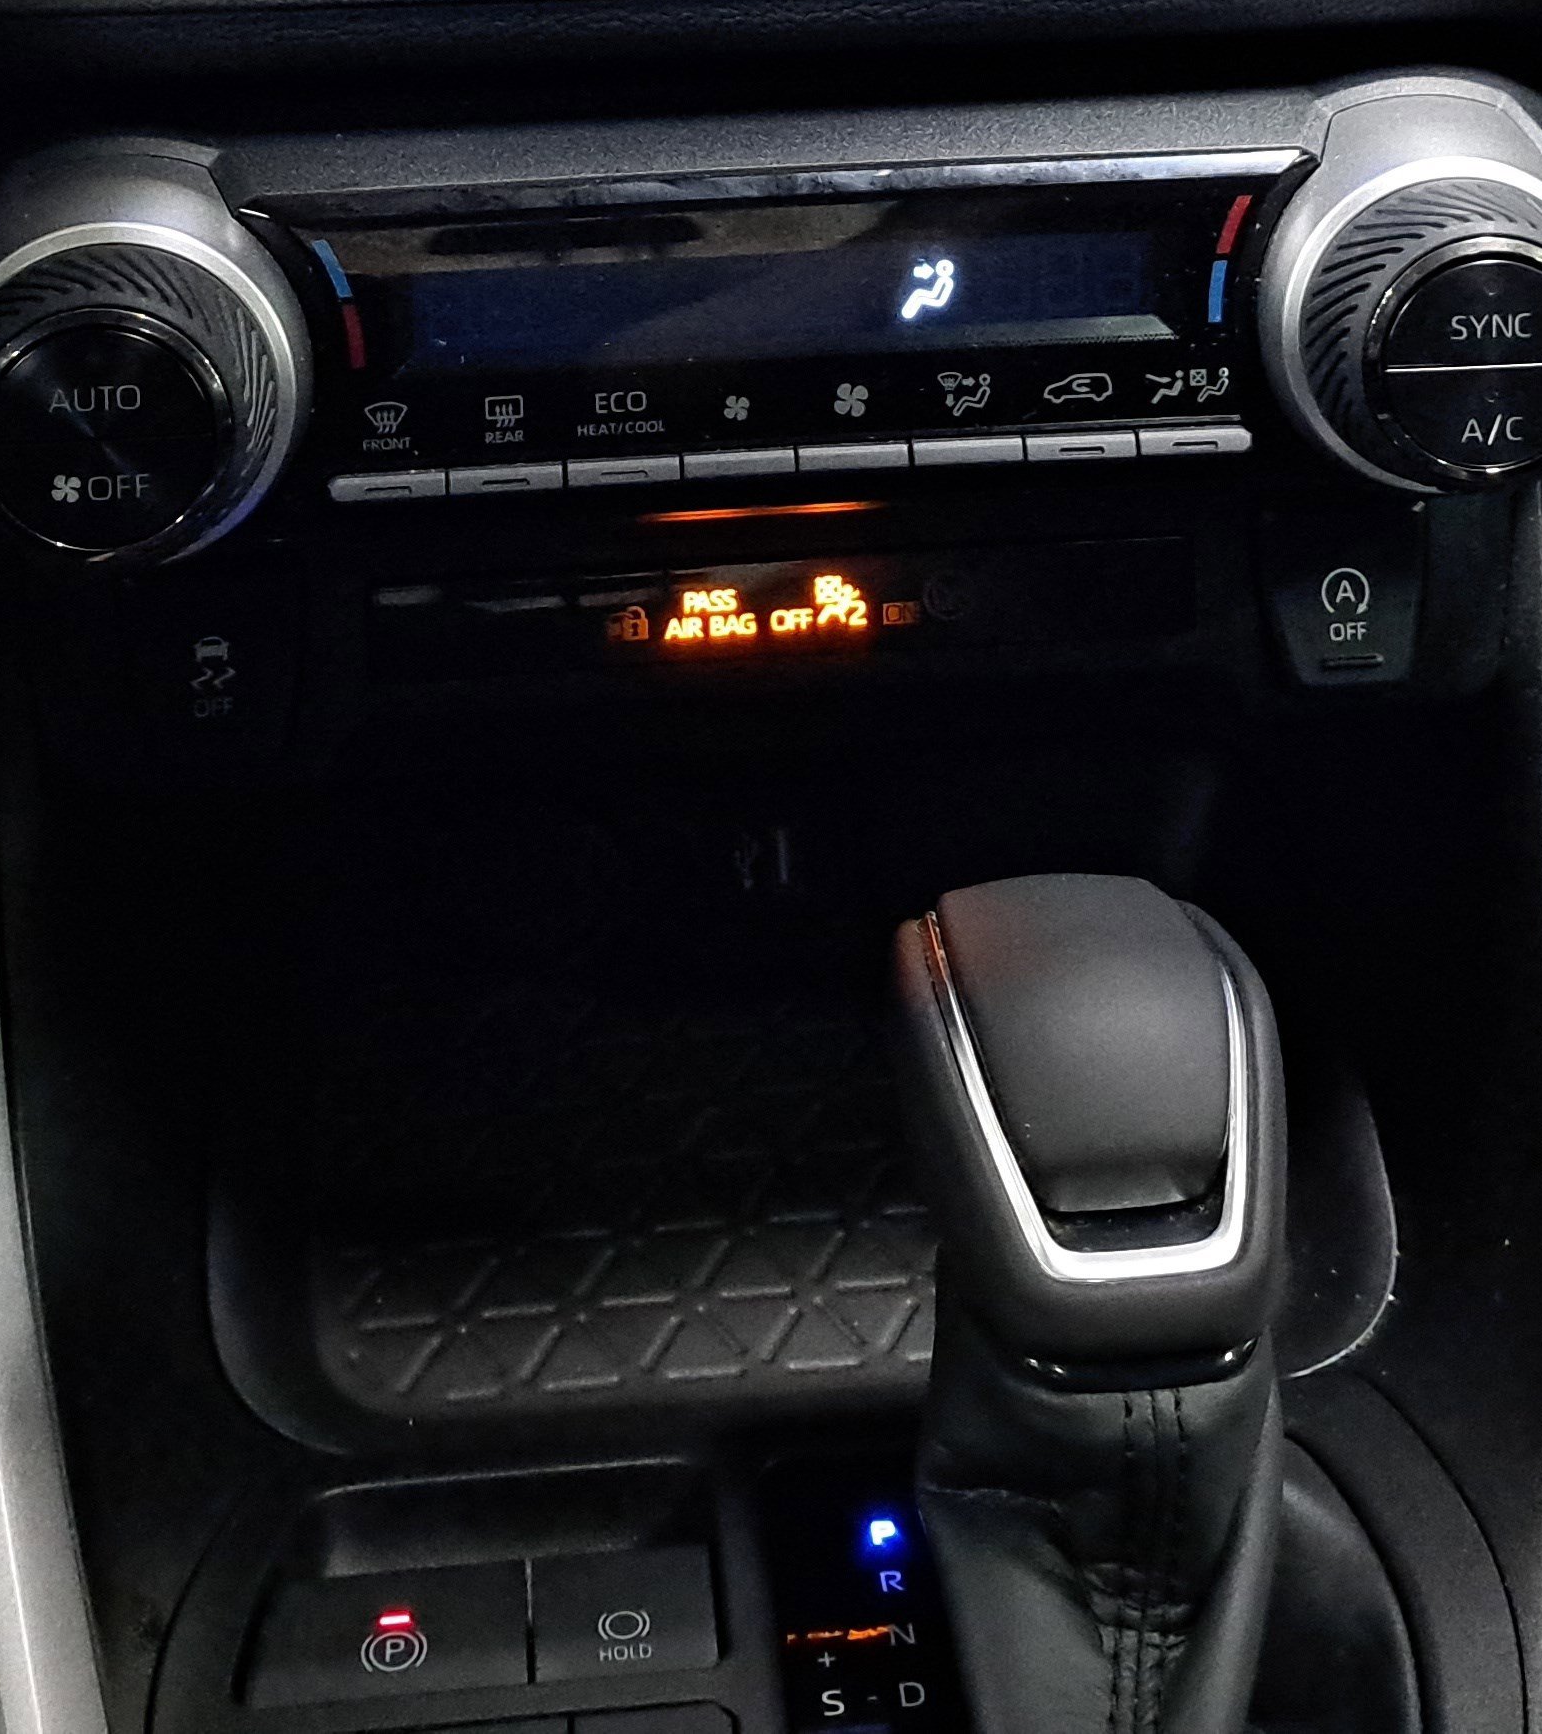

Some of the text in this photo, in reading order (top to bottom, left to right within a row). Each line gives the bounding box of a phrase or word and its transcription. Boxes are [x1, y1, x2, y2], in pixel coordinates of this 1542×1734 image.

[1450, 312, 1532, 340] SYNC
[49, 384, 141, 413] AUTO
[595, 391, 647, 414] ECO
[485, 430, 524, 444] REAR
[577, 420, 666, 437] HEAT/COOL
[1461, 414, 1523, 446] A/C
[362, 437, 412, 451] FRONT
[87, 473, 151, 501] OFF
[683, 588, 738, 614] PASS
[664, 608, 813, 640] AIR BAG OFF
[1329, 621, 1367, 641] OFF
[194, 697, 235, 718] OFF
[870, 1520, 897, 1546] P
[879, 1570, 905, 1593] R
[888, 1623, 916, 1646] N
[599, 1643, 652, 1662] HOLD
[821, 1688, 845, 1716] S
[899, 1681, 925, 1707] D
